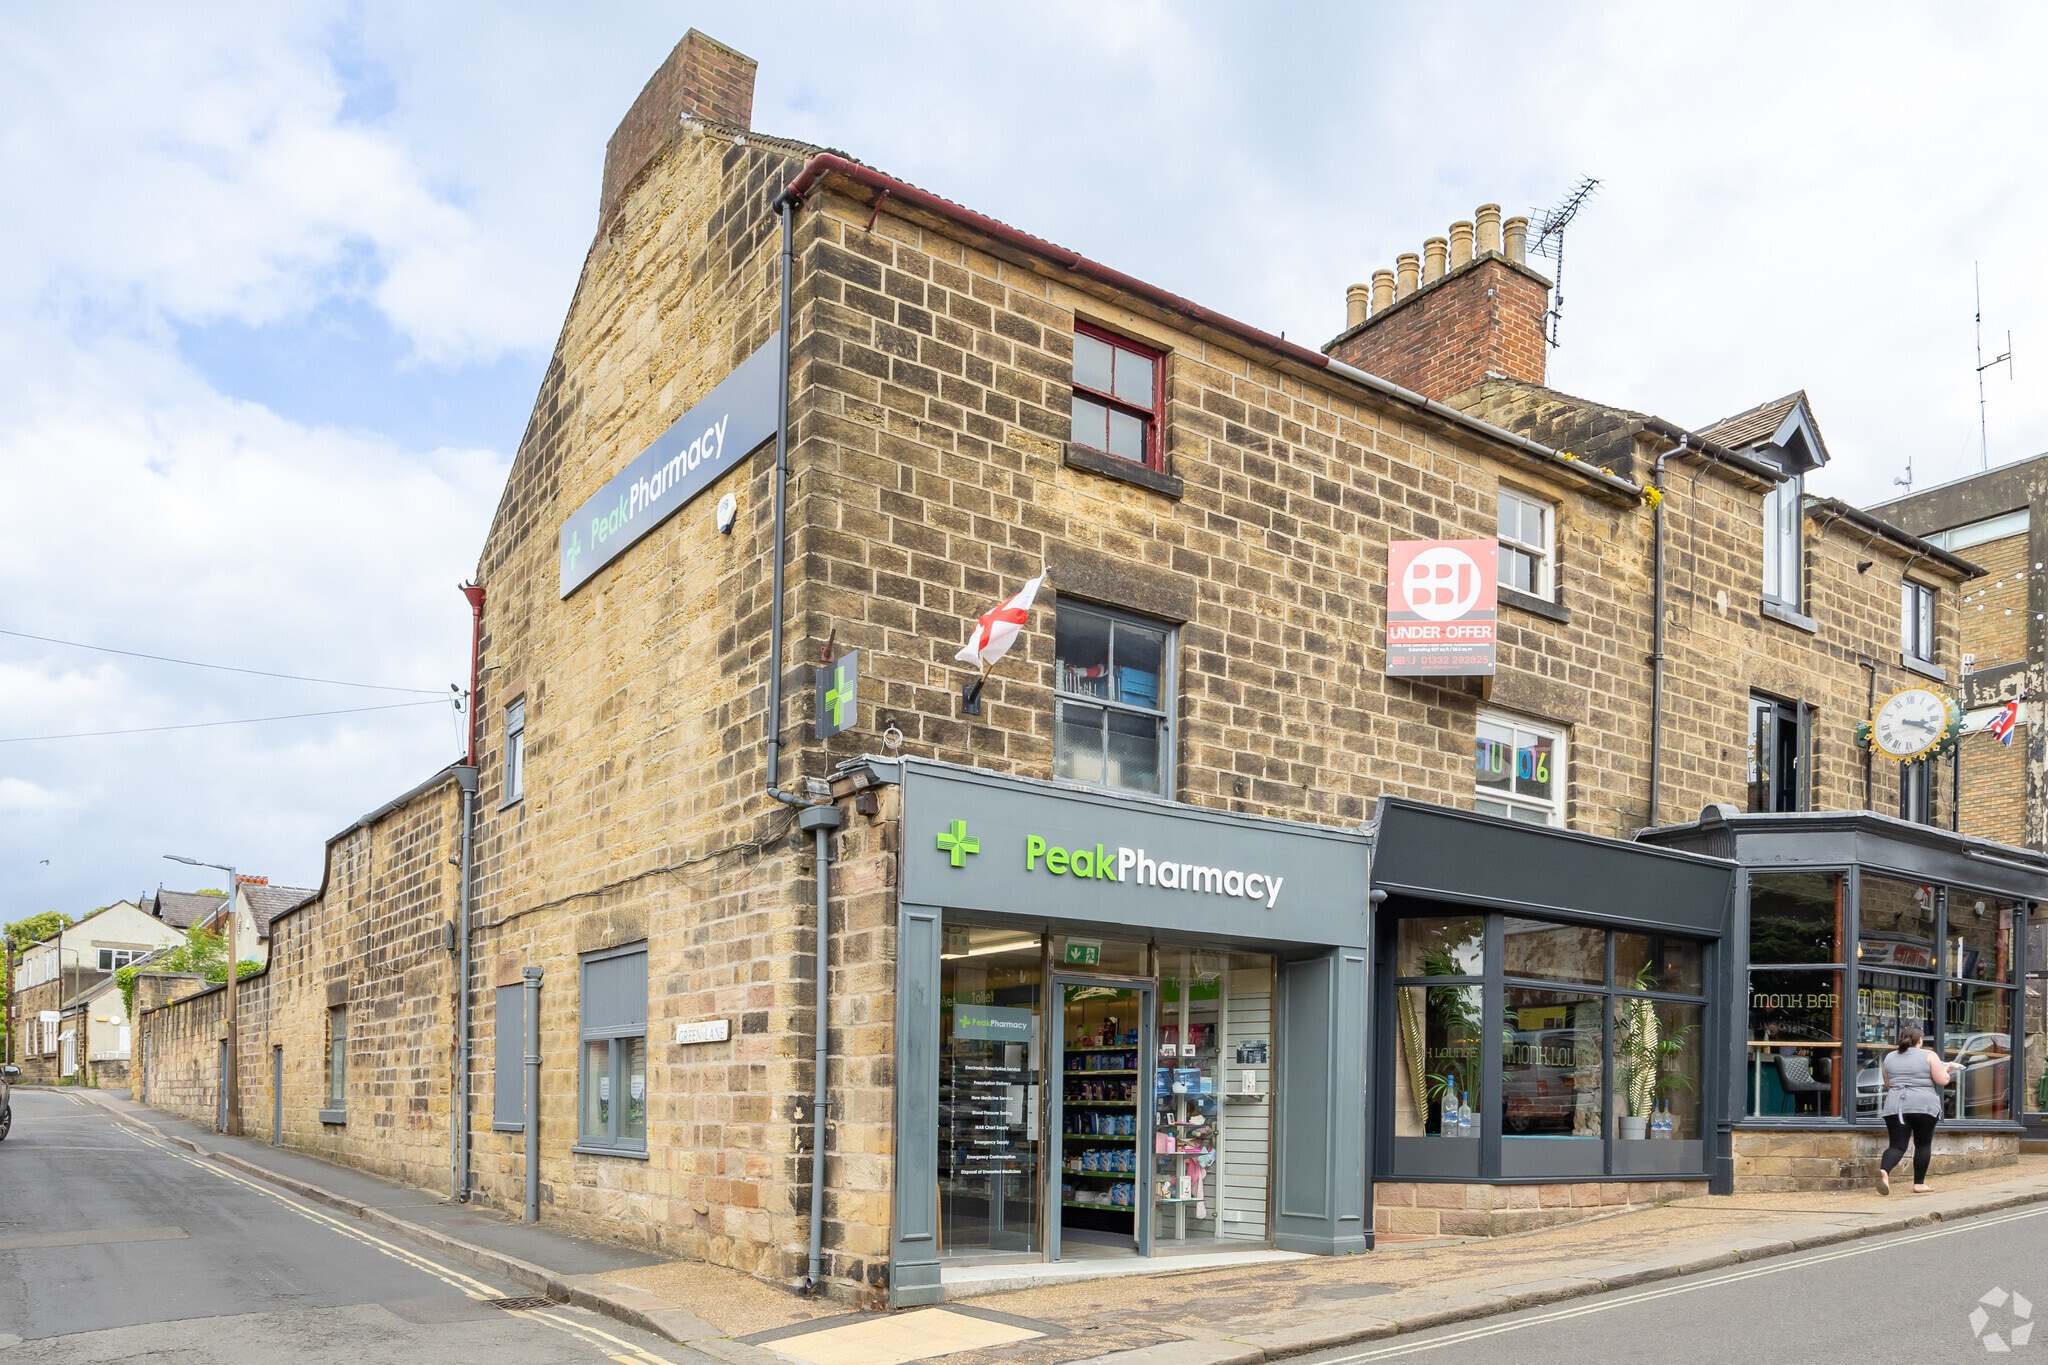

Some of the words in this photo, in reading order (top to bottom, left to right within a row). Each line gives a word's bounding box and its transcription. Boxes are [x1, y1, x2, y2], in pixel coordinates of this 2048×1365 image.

[591, 414, 729, 550] PeakPharmacy
[1390, 626, 1441, 639] UNDER
[1446, 625, 1492, 638] OFFER
[1421, 656, 1449, 665] 01332
[1452, 655, 1489, 665] 292825
[1026, 834, 1284, 909] PeakPharmacy
[1752, 993, 1803, 1008] MONK
[1806, 993, 1840, 1008] BAR
[1857, 988, 1902, 1019] MONK
[1906, 992, 1934, 1021] BAR
[1945, 998, 1987, 1026] MONK
[1988, 1003, 2013, 1028] BAR
[971, 1018, 1027, 1030] PeakPharmacy
[678, 1029, 701, 1043] GREEN
[705, 1027, 725, 1041] LANE
[1508, 1044, 1549, 1066] MONK
